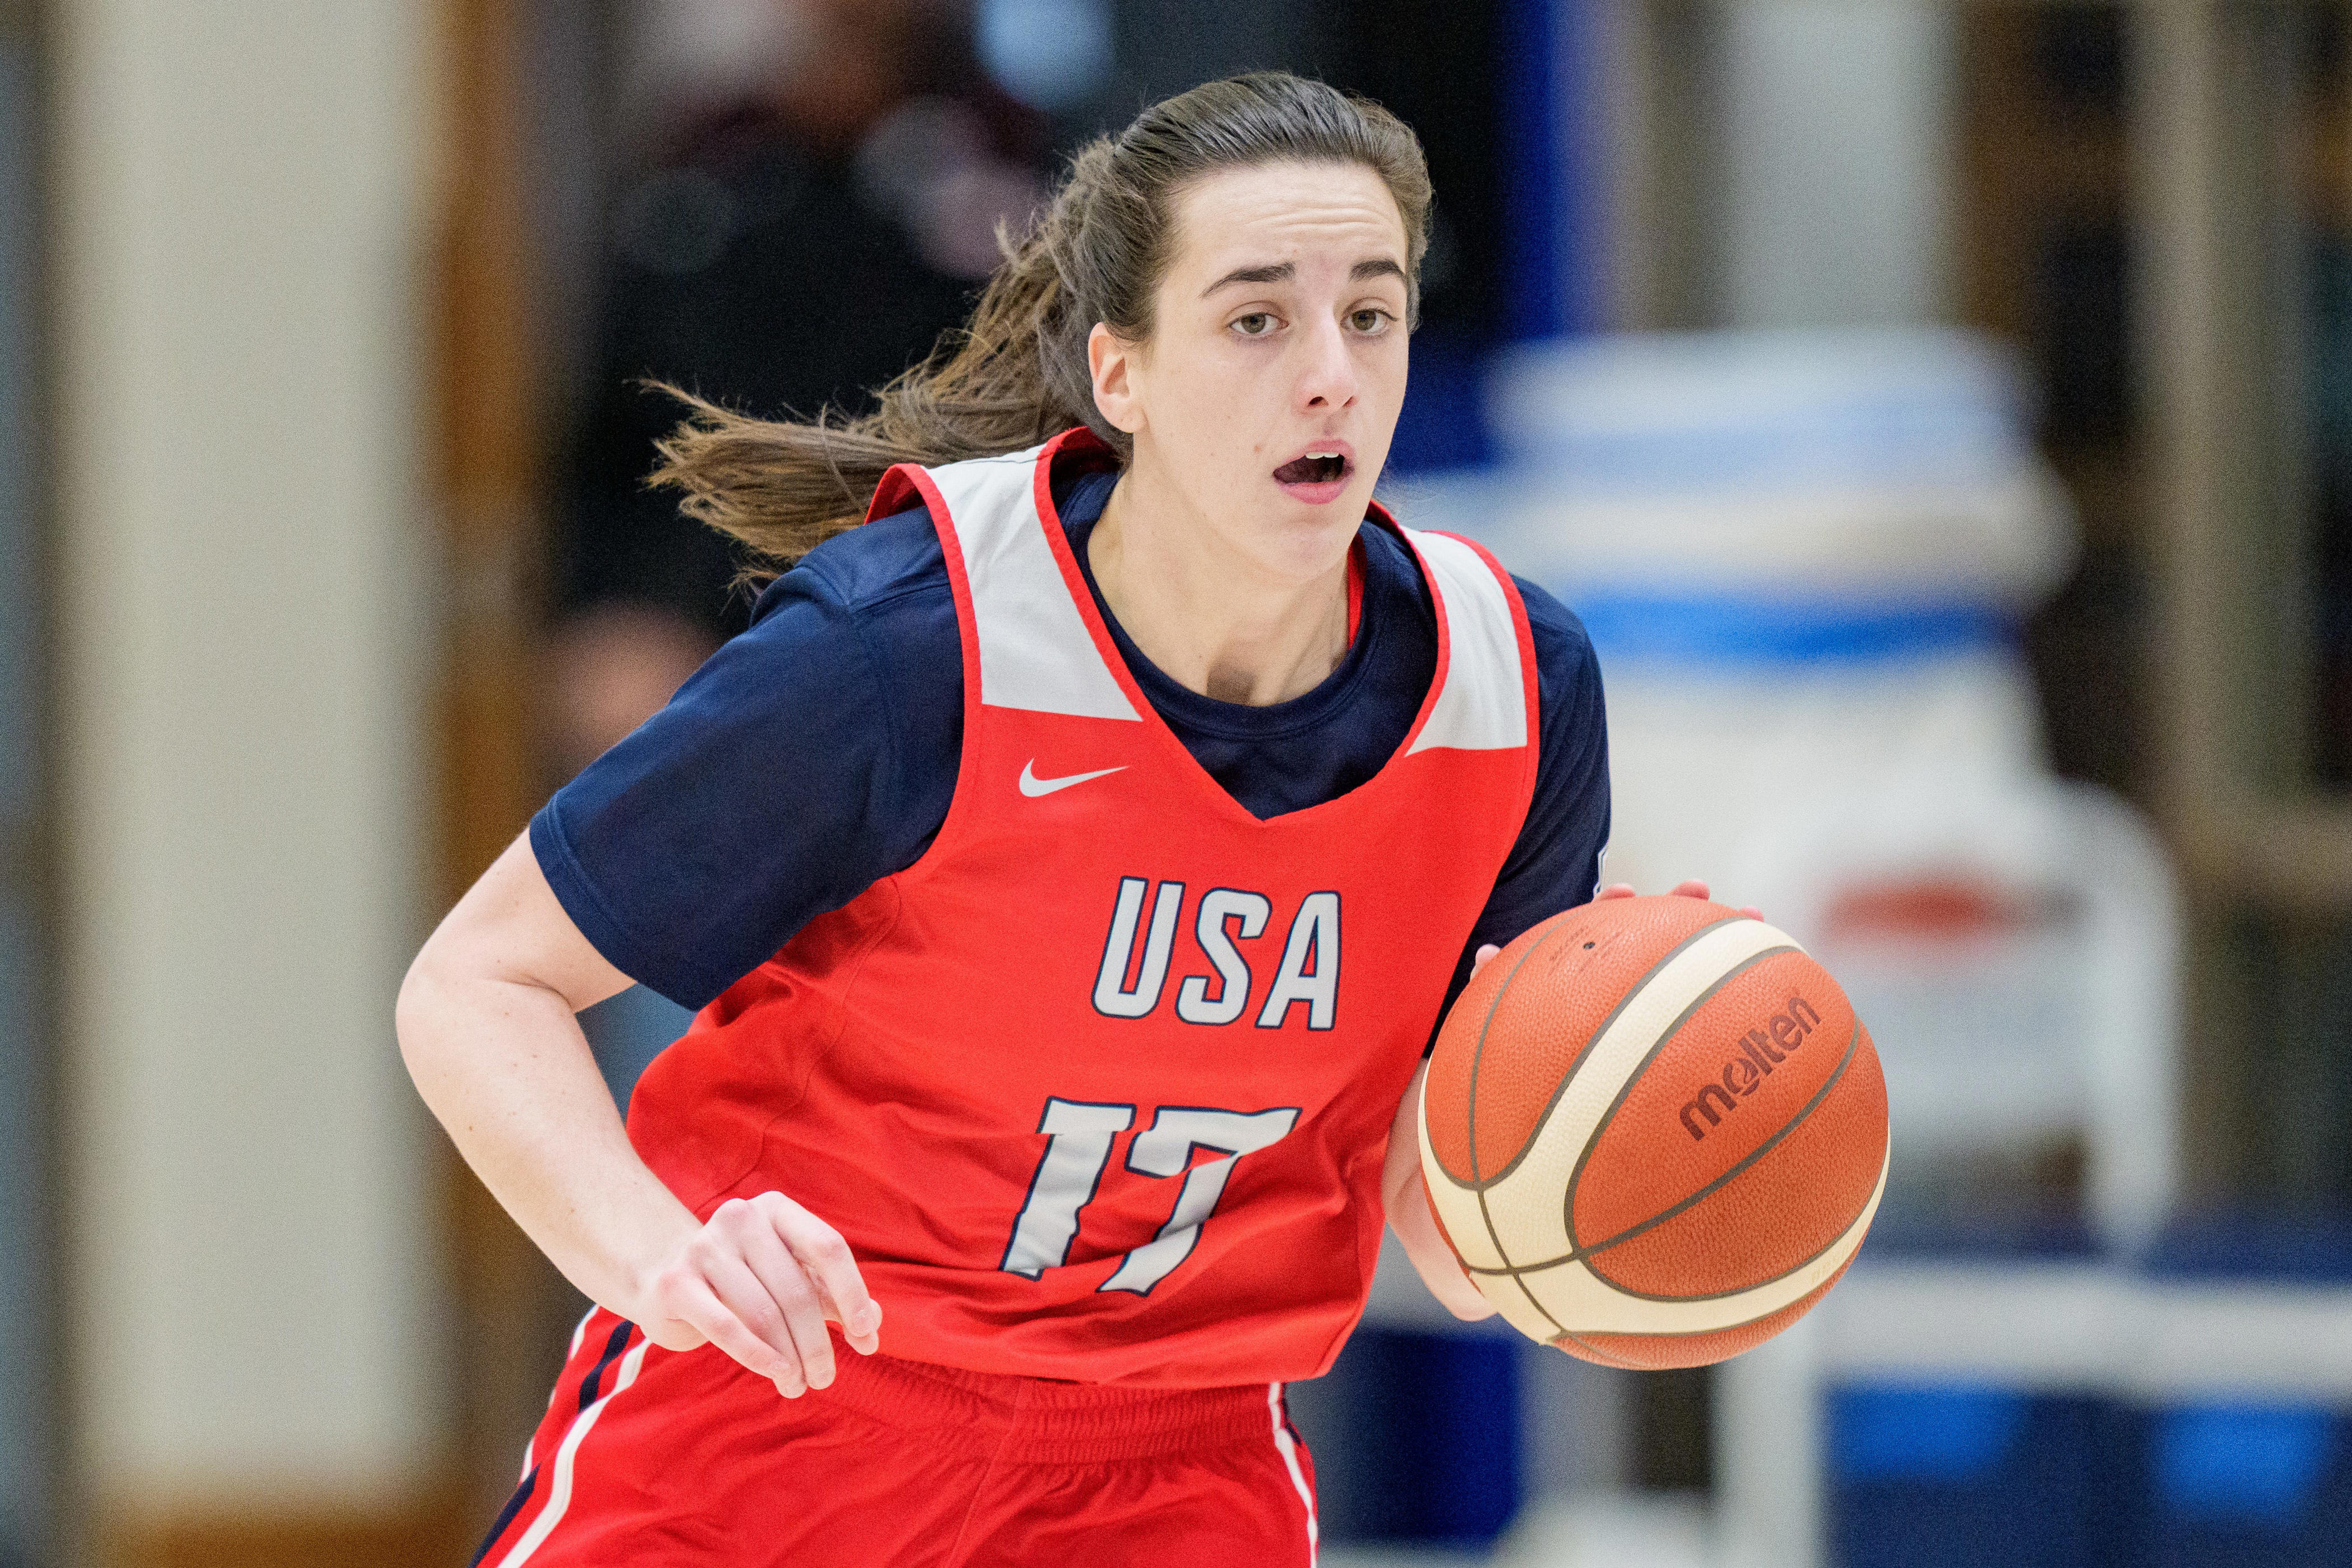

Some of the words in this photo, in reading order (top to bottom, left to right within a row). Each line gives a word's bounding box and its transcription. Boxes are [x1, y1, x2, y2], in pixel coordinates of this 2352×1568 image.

[1092, 876, 1342, 1031] USA
[1679, 997, 1821, 1141] molten
[998, 1096, 1302, 1297] 17
